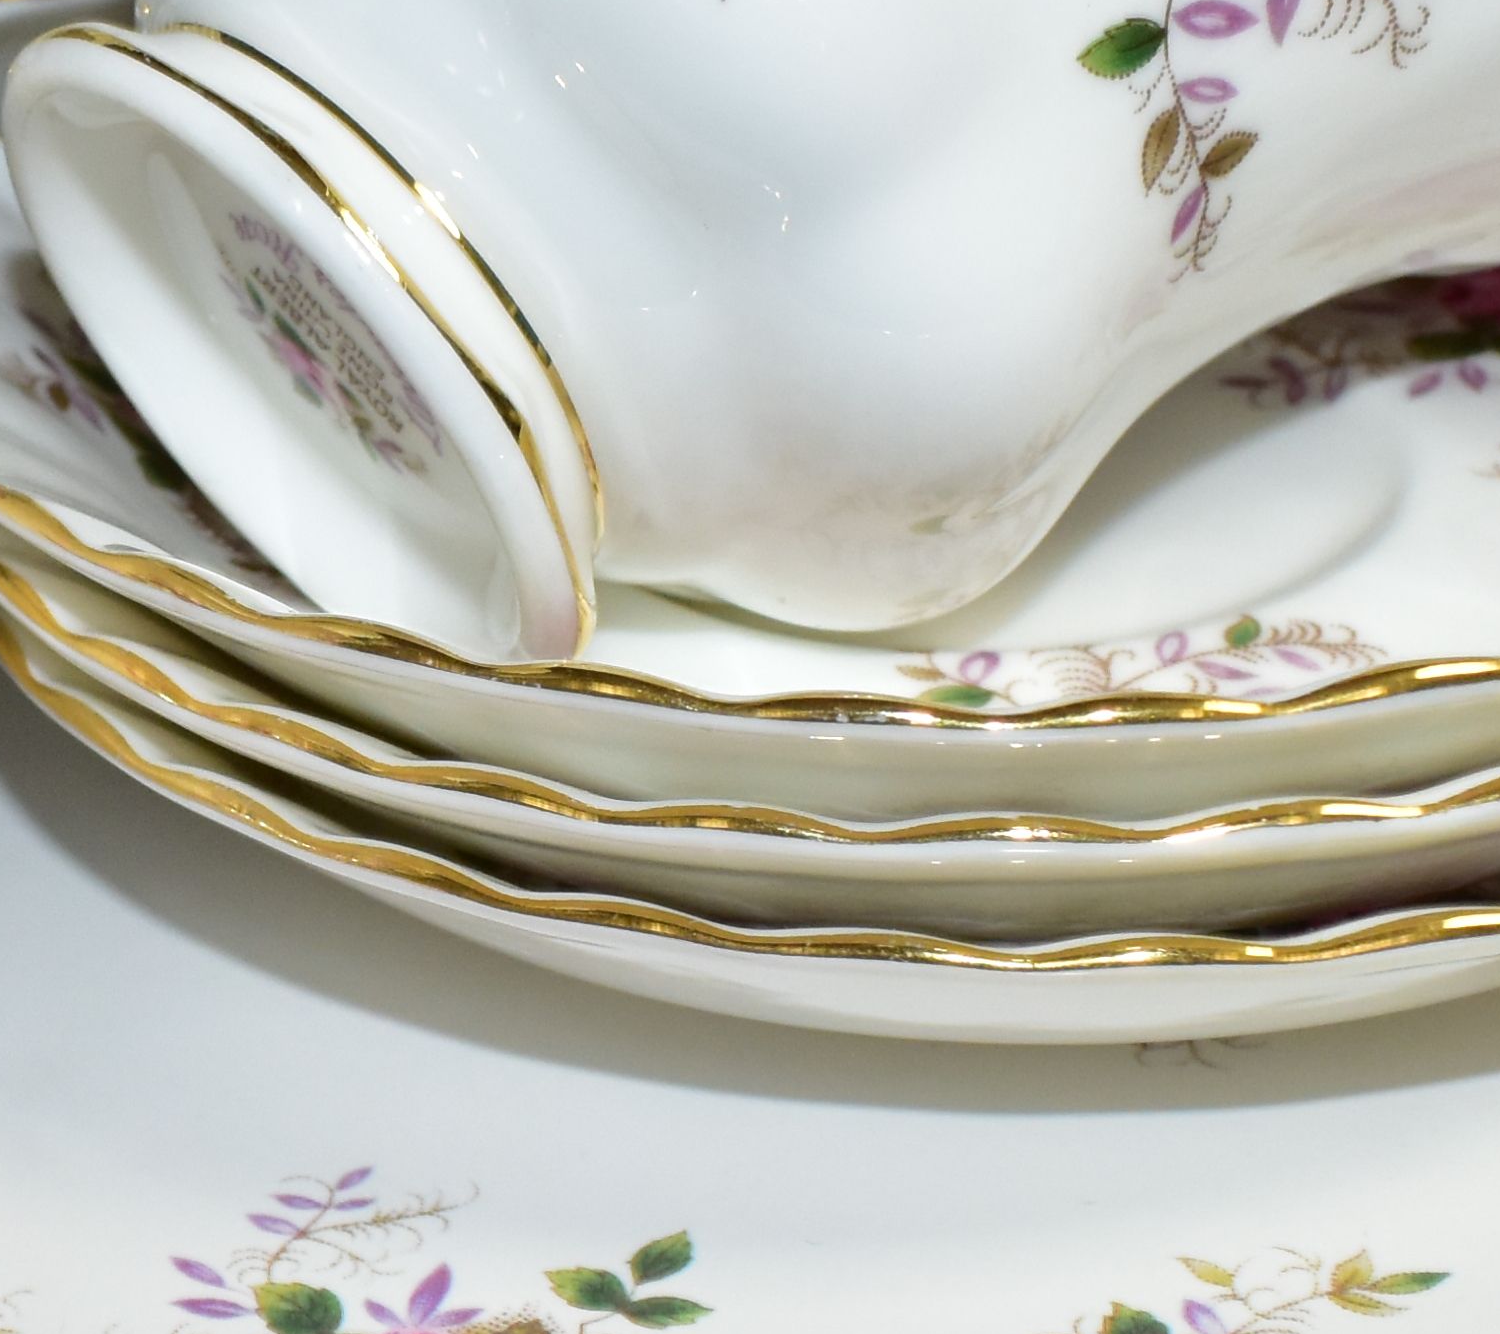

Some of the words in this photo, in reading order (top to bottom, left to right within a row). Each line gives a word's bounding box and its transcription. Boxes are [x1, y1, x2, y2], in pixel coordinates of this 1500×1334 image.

[249, 265, 330, 353] ALBERT
[287, 273, 384, 382] ENGLAND
[324, 353, 403, 434] ROYAL
